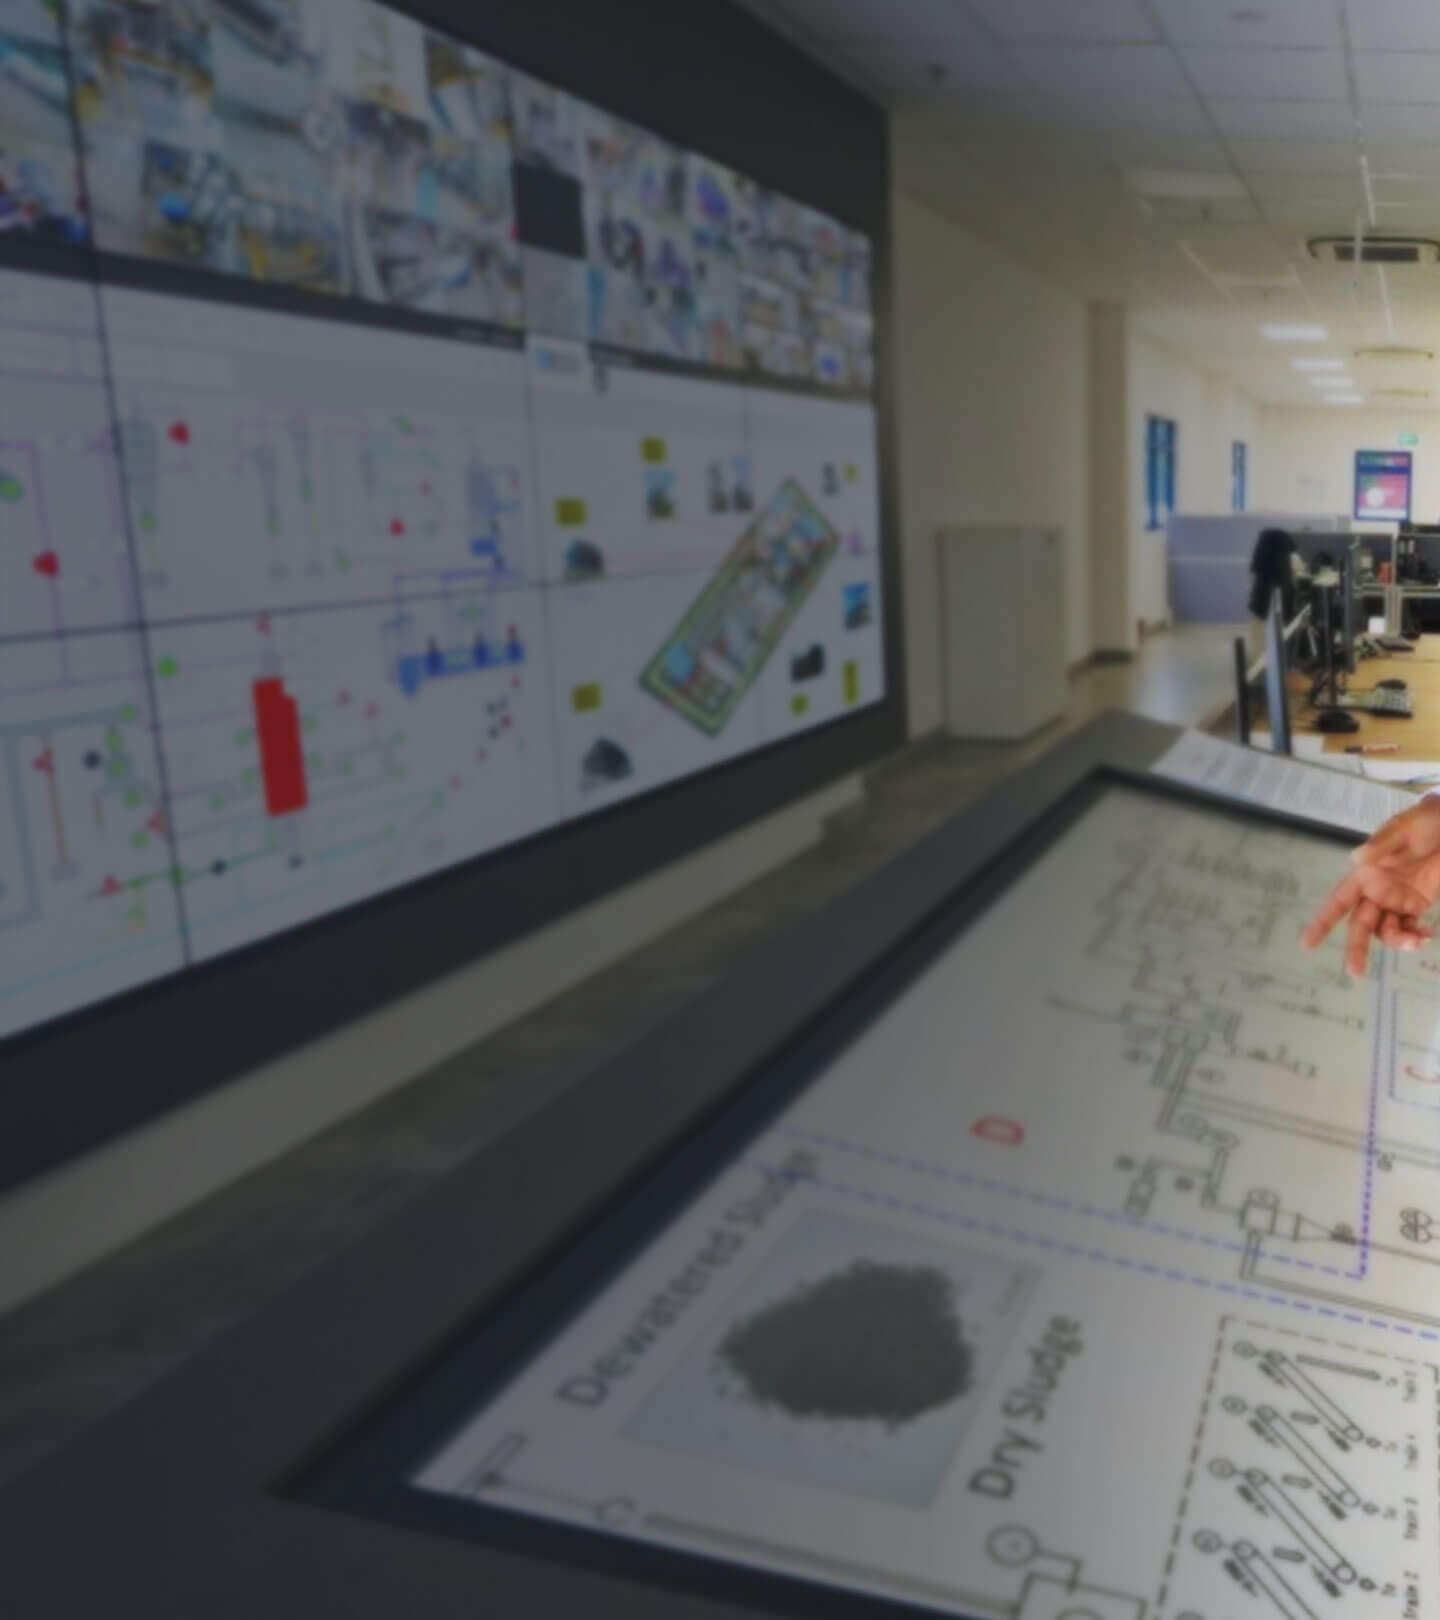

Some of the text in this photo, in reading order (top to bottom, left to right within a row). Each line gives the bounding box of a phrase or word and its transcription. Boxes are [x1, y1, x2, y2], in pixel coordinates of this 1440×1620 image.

[555, 1226, 745, 1408] Dewatered
[968, 1314, 1085, 1501] Dry Sludge
